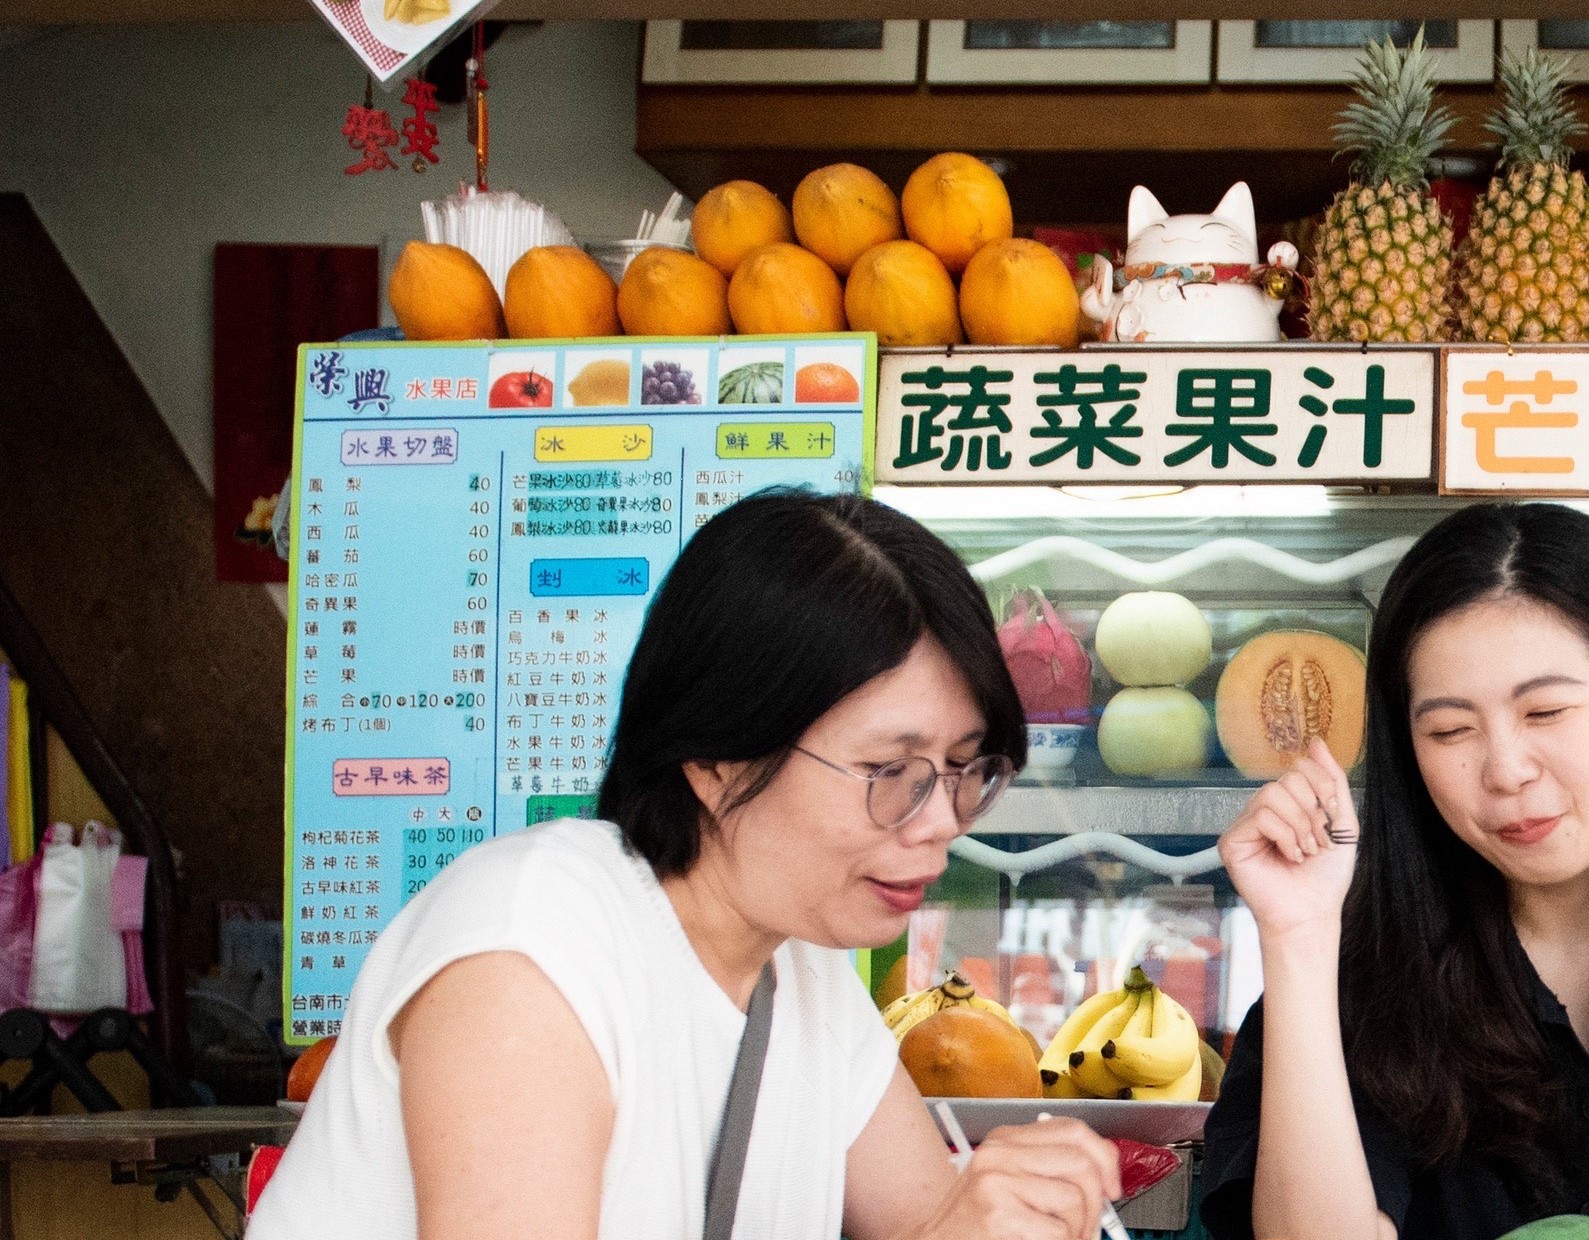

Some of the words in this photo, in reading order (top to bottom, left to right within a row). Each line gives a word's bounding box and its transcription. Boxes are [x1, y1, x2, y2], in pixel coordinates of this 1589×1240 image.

[309, 351, 390, 412] 榮興
[405, 377, 479, 400] 水果店
[892, 363, 1416, 472] 蔬菜果汁
[347, 435, 454, 458] 水果切盤
[540, 433, 646, 453] 冰沙
[724, 431, 832, 452] 鮮果汁
[469, 475, 491, 491] 40
[695, 470, 745, 485] 西瓜汁
[833, 470, 854, 483] 40
[308, 501, 360, 516] 木瓜
[469, 500, 490, 515] 40
[307, 524, 360, 540] 西瓜
[468, 524, 490, 539] 40
[468, 548, 489, 563] 60
[305, 573, 358, 588] 哈密瓜
[468, 572, 488, 587] 70
[305, 596, 358, 612] 奇異果
[467, 596, 488, 611] 60
[508, 609, 608, 624] 百香果冰
[453, 620, 487, 636] 時價
[452, 644, 486, 659] 時價
[507, 651, 608, 666] 巧克力牛奶冰
[452, 668, 486, 684] 時價
[507, 671, 607, 686] 紅豆牛奶冰
[507, 692, 607, 707] 八寶豆牛奶冰
[465, 716, 486, 733] 40
[507, 713, 607, 728] 布丁牛奶冰
[506, 735, 607, 750] 水果牛奶冰
[334, 766, 447, 788] 古早味茶
[408, 829, 428, 844] 40
[436, 828, 456, 842] 50
[301, 855, 380, 871] 洛神花茶
[408, 855, 427, 870] 30
[301, 880, 380, 895] 古早味紅茶
[301, 905, 379, 920] 鮮奶紅茶
